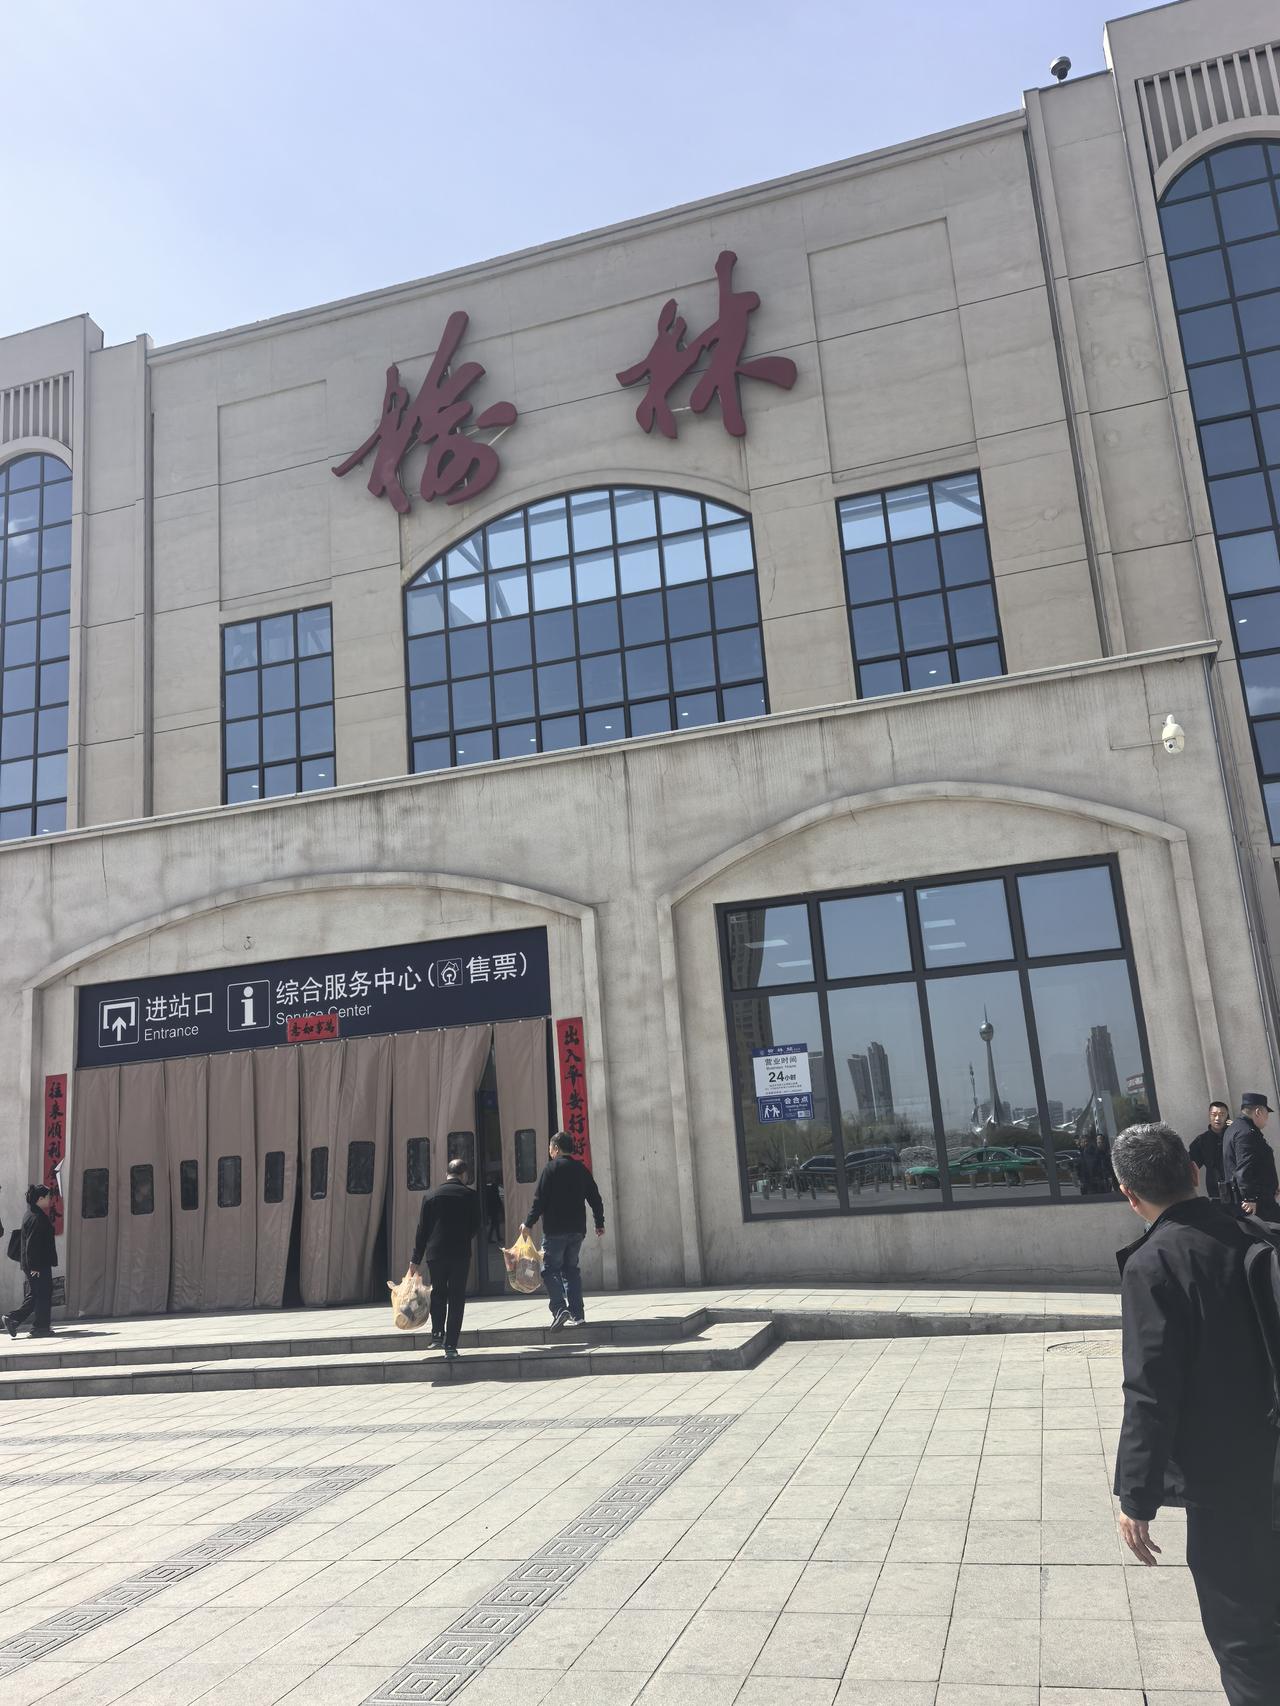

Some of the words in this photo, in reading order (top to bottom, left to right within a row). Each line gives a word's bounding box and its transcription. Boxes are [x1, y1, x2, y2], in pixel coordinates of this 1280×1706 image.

[145, 990, 213, 1022] 进站口
[328, 1004, 372, 1019] Center
[145, 1023, 199, 1041] Entrance
[765, 1055, 798, 1066] 营业时间
[768, 1071, 797, 1083] 24小时
[563, 1024, 587, 1163] 出入平安行好
[784, 1095, 809, 1105] 会合点
